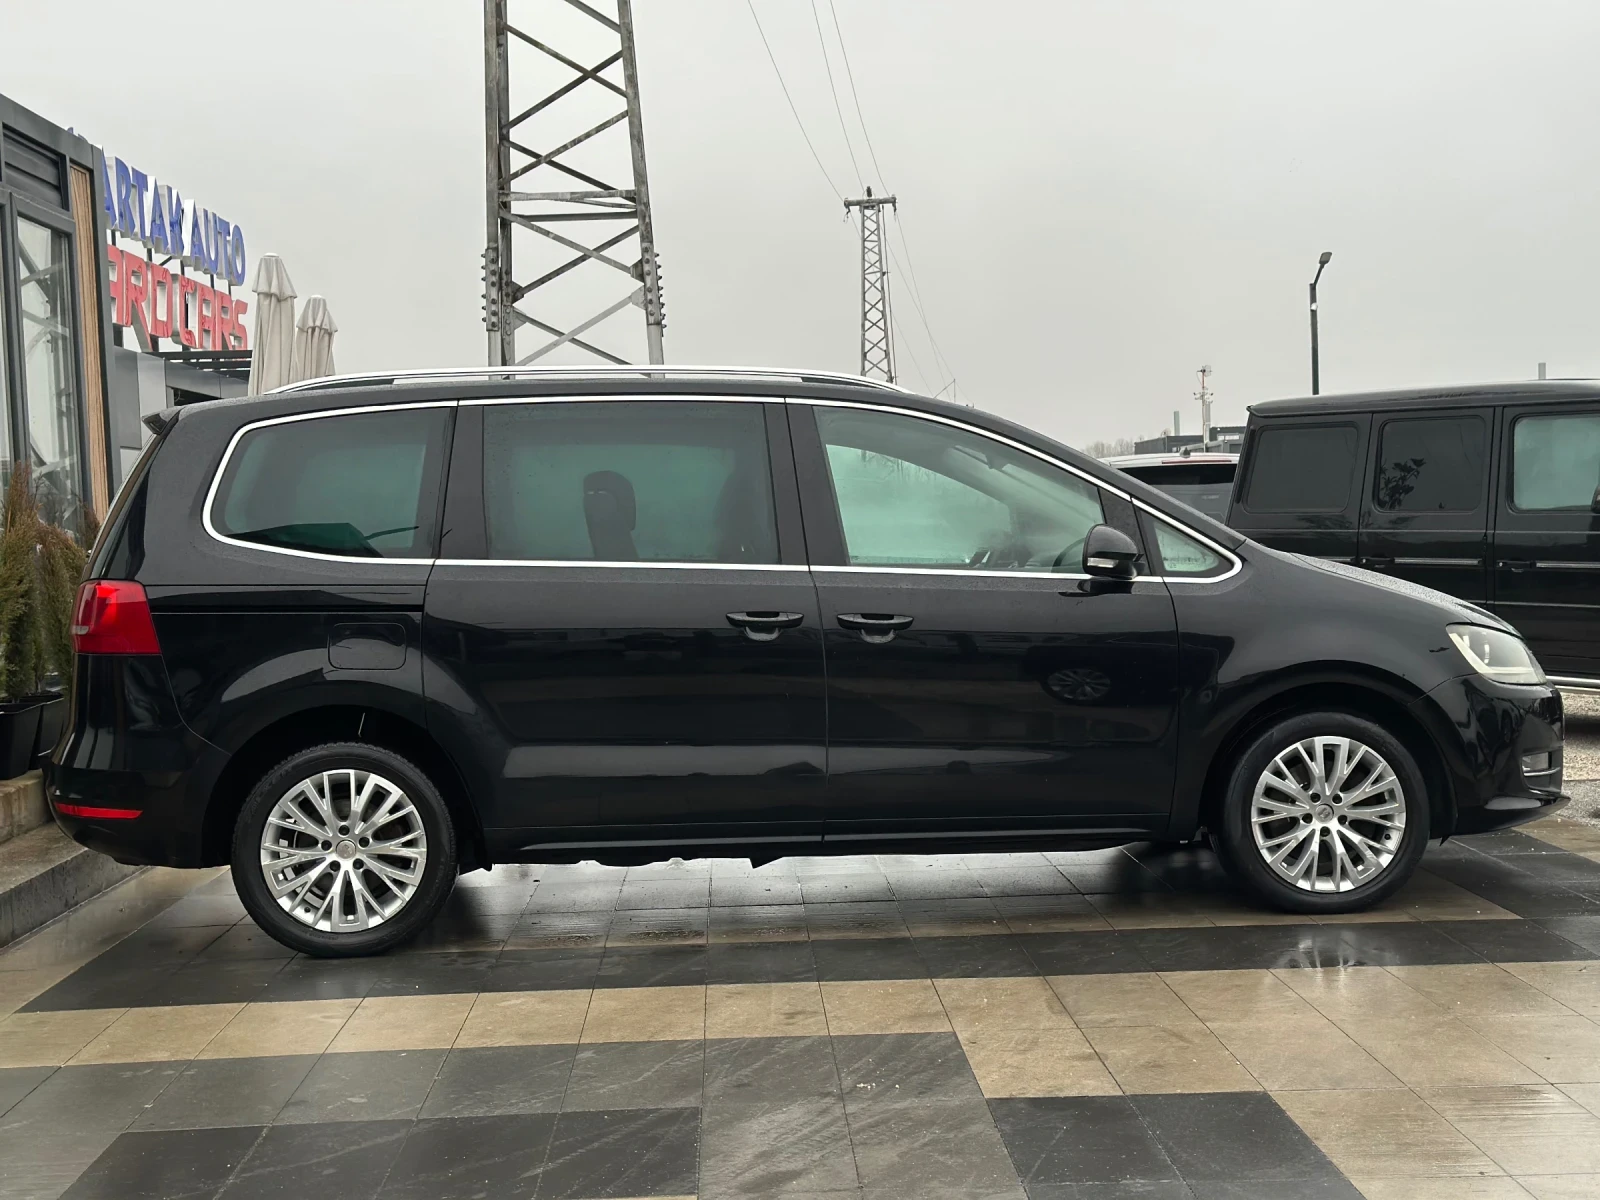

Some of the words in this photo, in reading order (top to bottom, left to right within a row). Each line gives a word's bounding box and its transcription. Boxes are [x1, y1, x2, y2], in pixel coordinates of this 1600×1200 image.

[67, 127, 184, 255] ARTAK
[190, 199, 246, 286] AUTO
[178, 275, 248, 351] CARS
